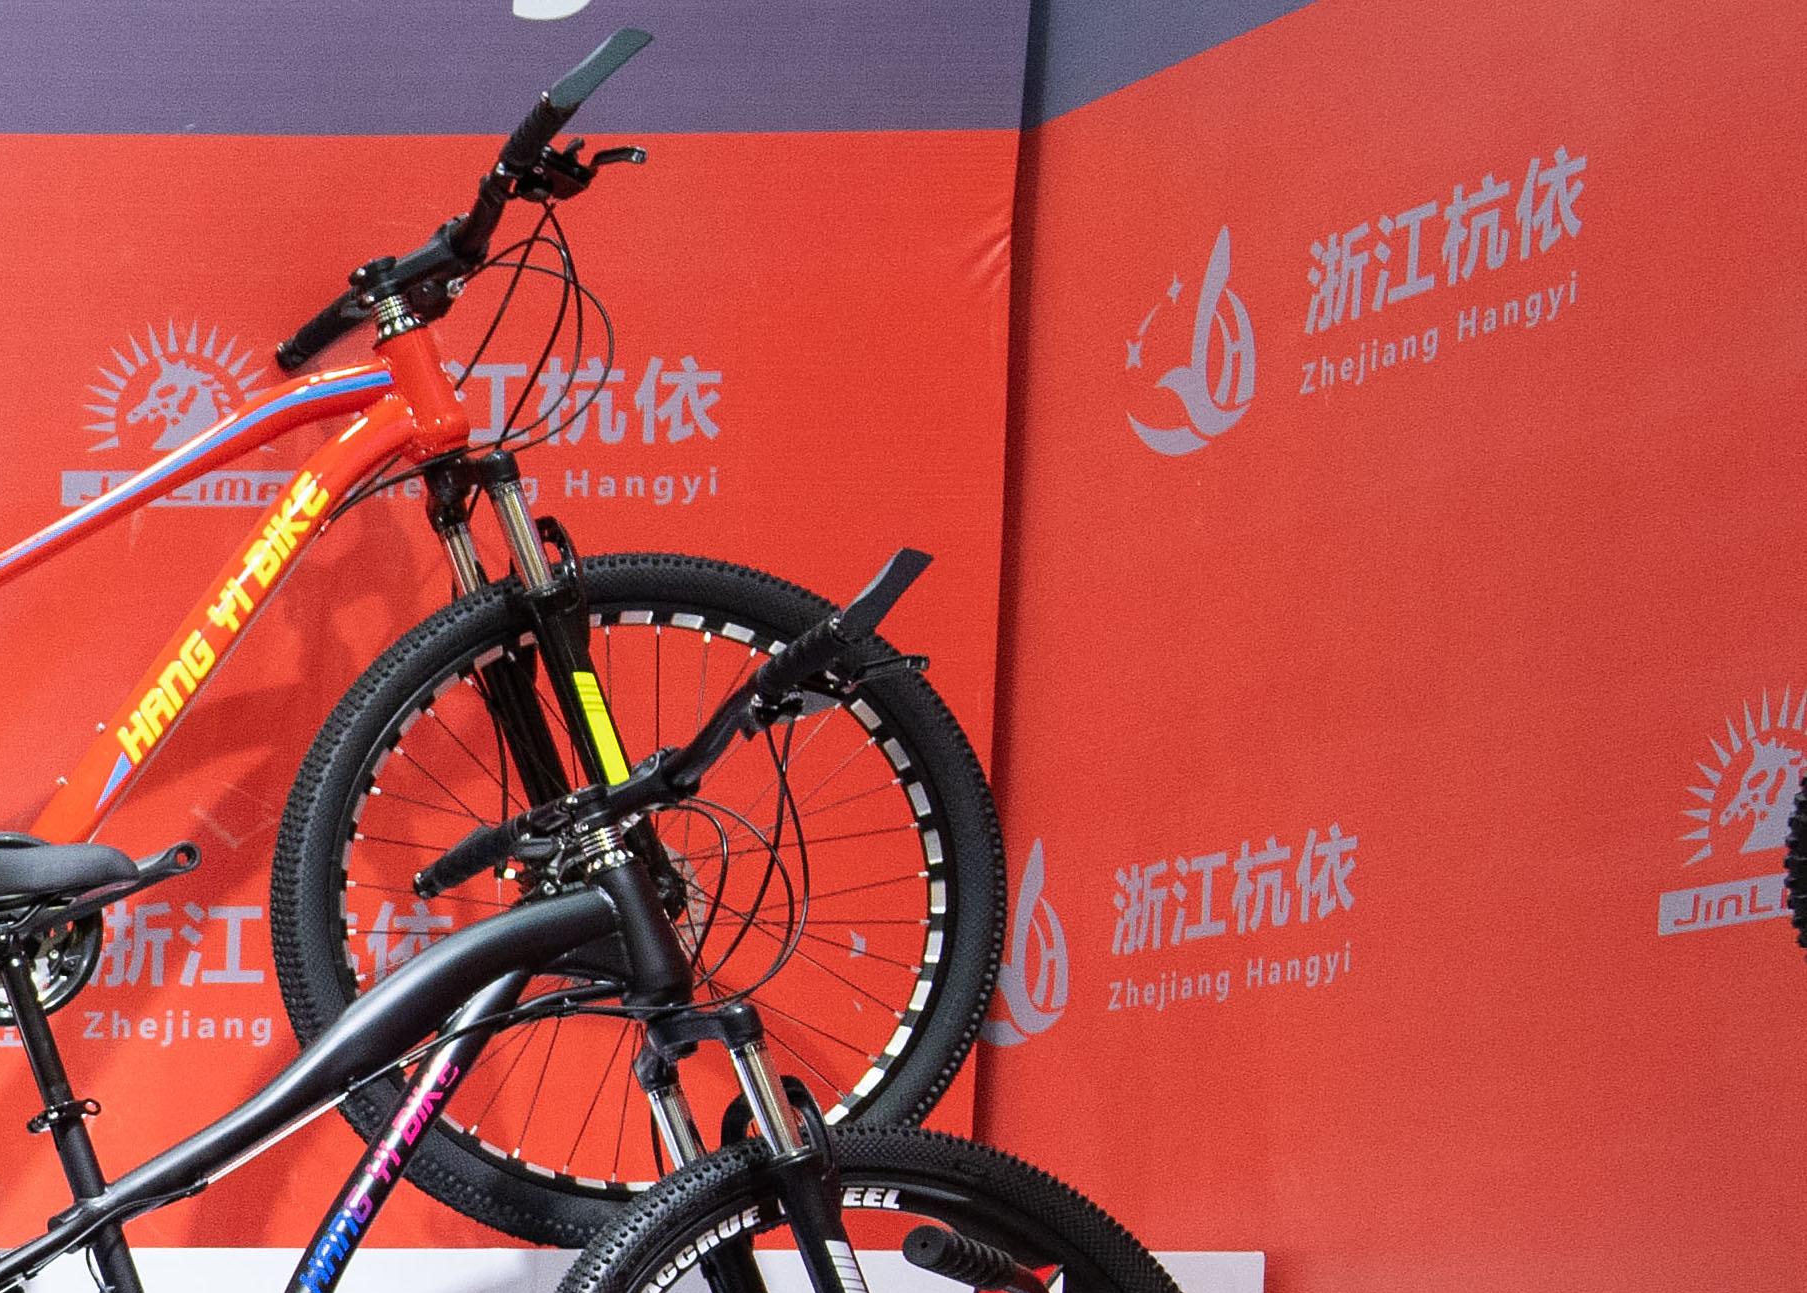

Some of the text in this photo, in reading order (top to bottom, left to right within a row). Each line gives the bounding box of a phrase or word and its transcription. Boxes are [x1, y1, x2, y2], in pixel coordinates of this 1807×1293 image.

[1304, 146, 1587, 336] 浙江杭依
[1300, 271, 1578, 396] Zhejiang Hangyi
[446, 356, 723, 447] 江杭依
[564, 466, 720, 505] Hangyi
[117, 471, 330, 766] HANG YI BIKE
[1111, 822, 1358, 955] 浙江杭依
[82, 1012, 273, 1049] Zhejiang
[1107, 942, 1353, 1011] Zhejiang Hangyi
[365, 1130, 407, 1196] YI
[400, 1059, 463, 1149] BIKE
